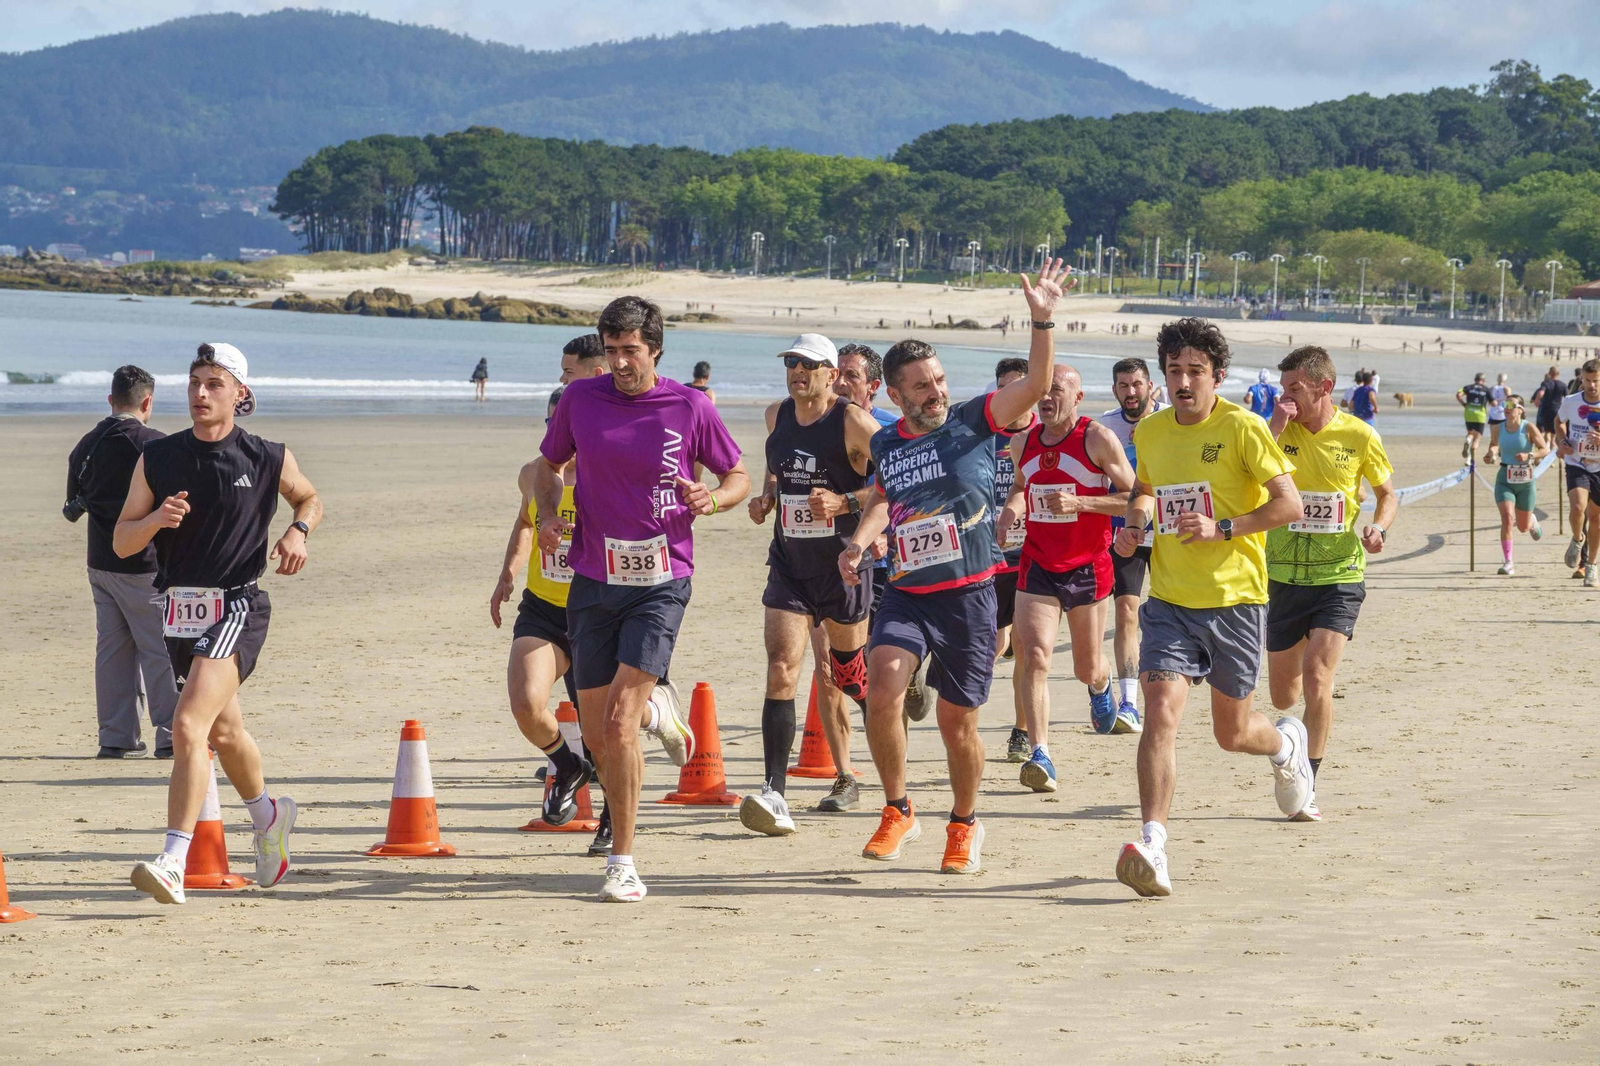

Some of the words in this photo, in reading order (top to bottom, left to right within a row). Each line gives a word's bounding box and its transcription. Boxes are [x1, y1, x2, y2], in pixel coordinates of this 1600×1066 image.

[904, 441, 935, 456] seguros
[882, 448, 939, 481] CARREIRA
[902, 461, 947, 488] SAMIL
[652, 484, 660, 519] TELECOM
[1165, 497, 1197, 516] 477
[1303, 504, 1333, 519] 422
[909, 531, 943, 554] 279
[620, 554, 656, 571] 338
[177, 603, 207, 620] 610
